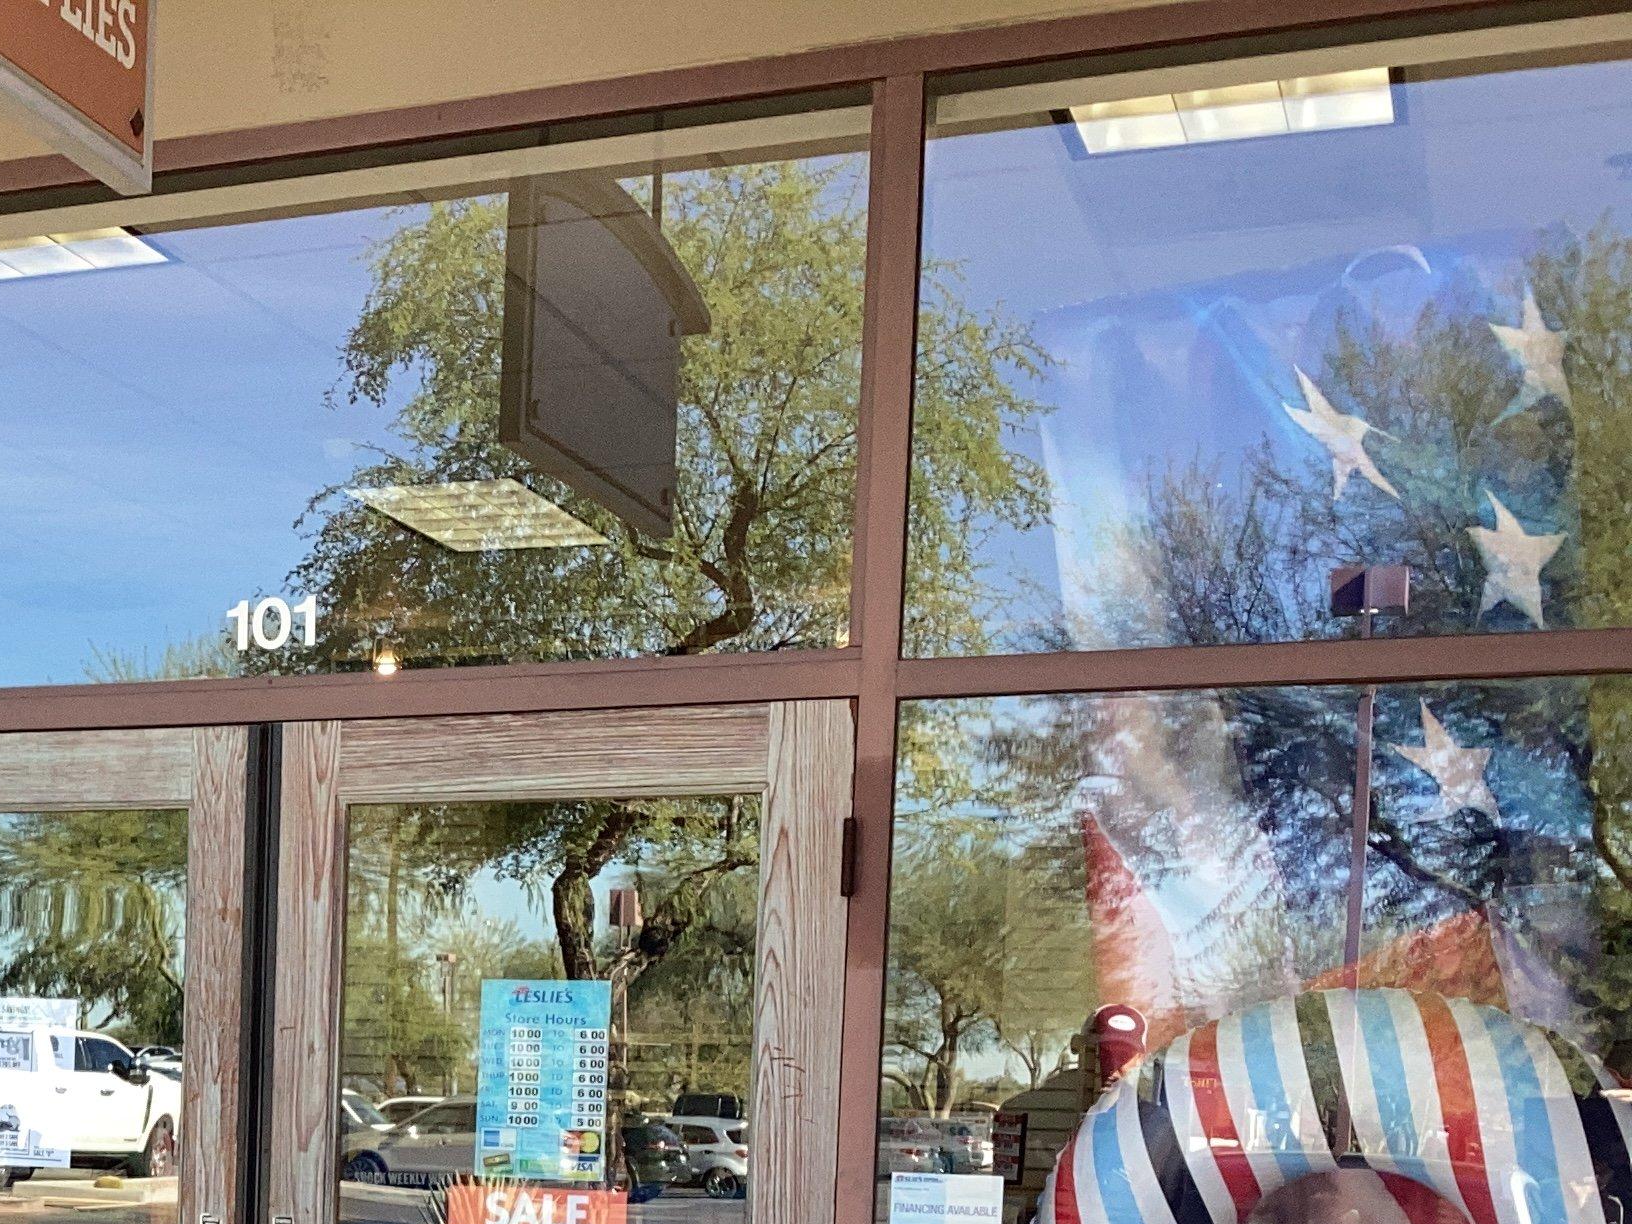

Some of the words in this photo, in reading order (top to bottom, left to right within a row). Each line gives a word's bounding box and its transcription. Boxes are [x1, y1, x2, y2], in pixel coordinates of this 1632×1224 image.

[40, 0, 135, 69] LIES
[227, 594, 317, 650] 101
[514, 988, 573, 1004] LESLIE'S
[505, 1013, 540, 1024] Store
[545, 1013, 587, 1026] Hours
[388, 1173, 427, 1185] WEEKLY
[894, 1203, 944, 1215] FINANCING
[947, 1205, 997, 1217] AVAILABLE
